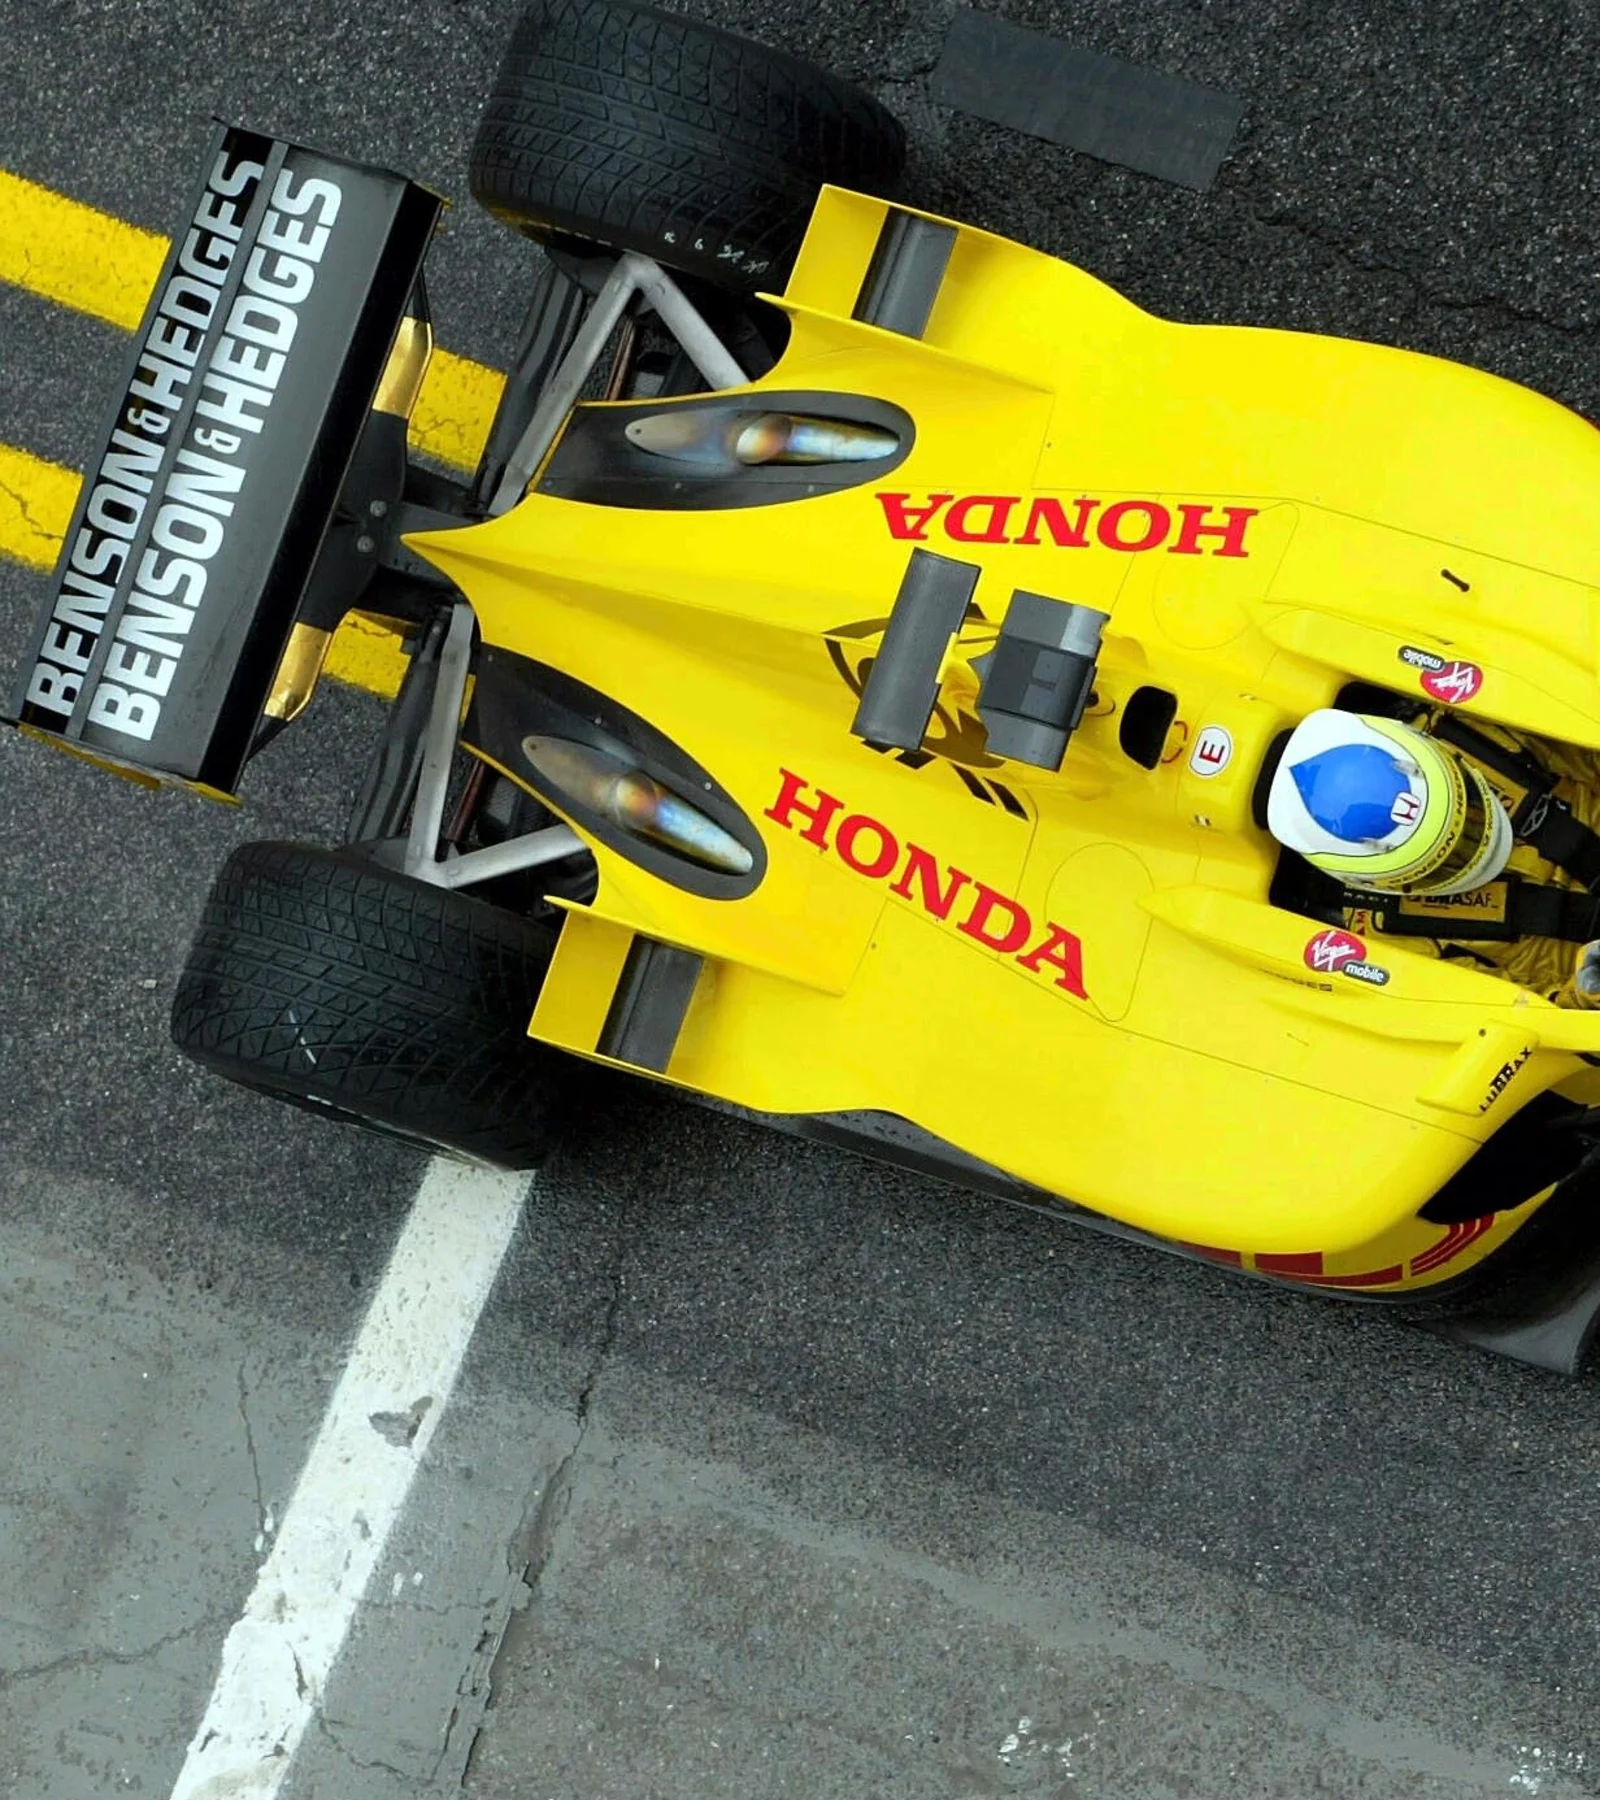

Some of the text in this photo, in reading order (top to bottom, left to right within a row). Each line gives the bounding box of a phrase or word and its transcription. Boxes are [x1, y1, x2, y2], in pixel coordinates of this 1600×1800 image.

[26, 151, 264, 718] BENSON & HEDGES
[87, 168, 342, 742] BENSON & HEDGES
[875, 493, 1258, 557] HONDA
[1403, 649, 1441, 668] mobile
[1431, 663, 1475, 703] Virgin
[764, 767, 1089, 1000] HONDA
[1311, 932, 1355, 970] Virgin
[1347, 962, 1384, 982] mobile
[1480, 1047, 1532, 1112] LUBRAX
